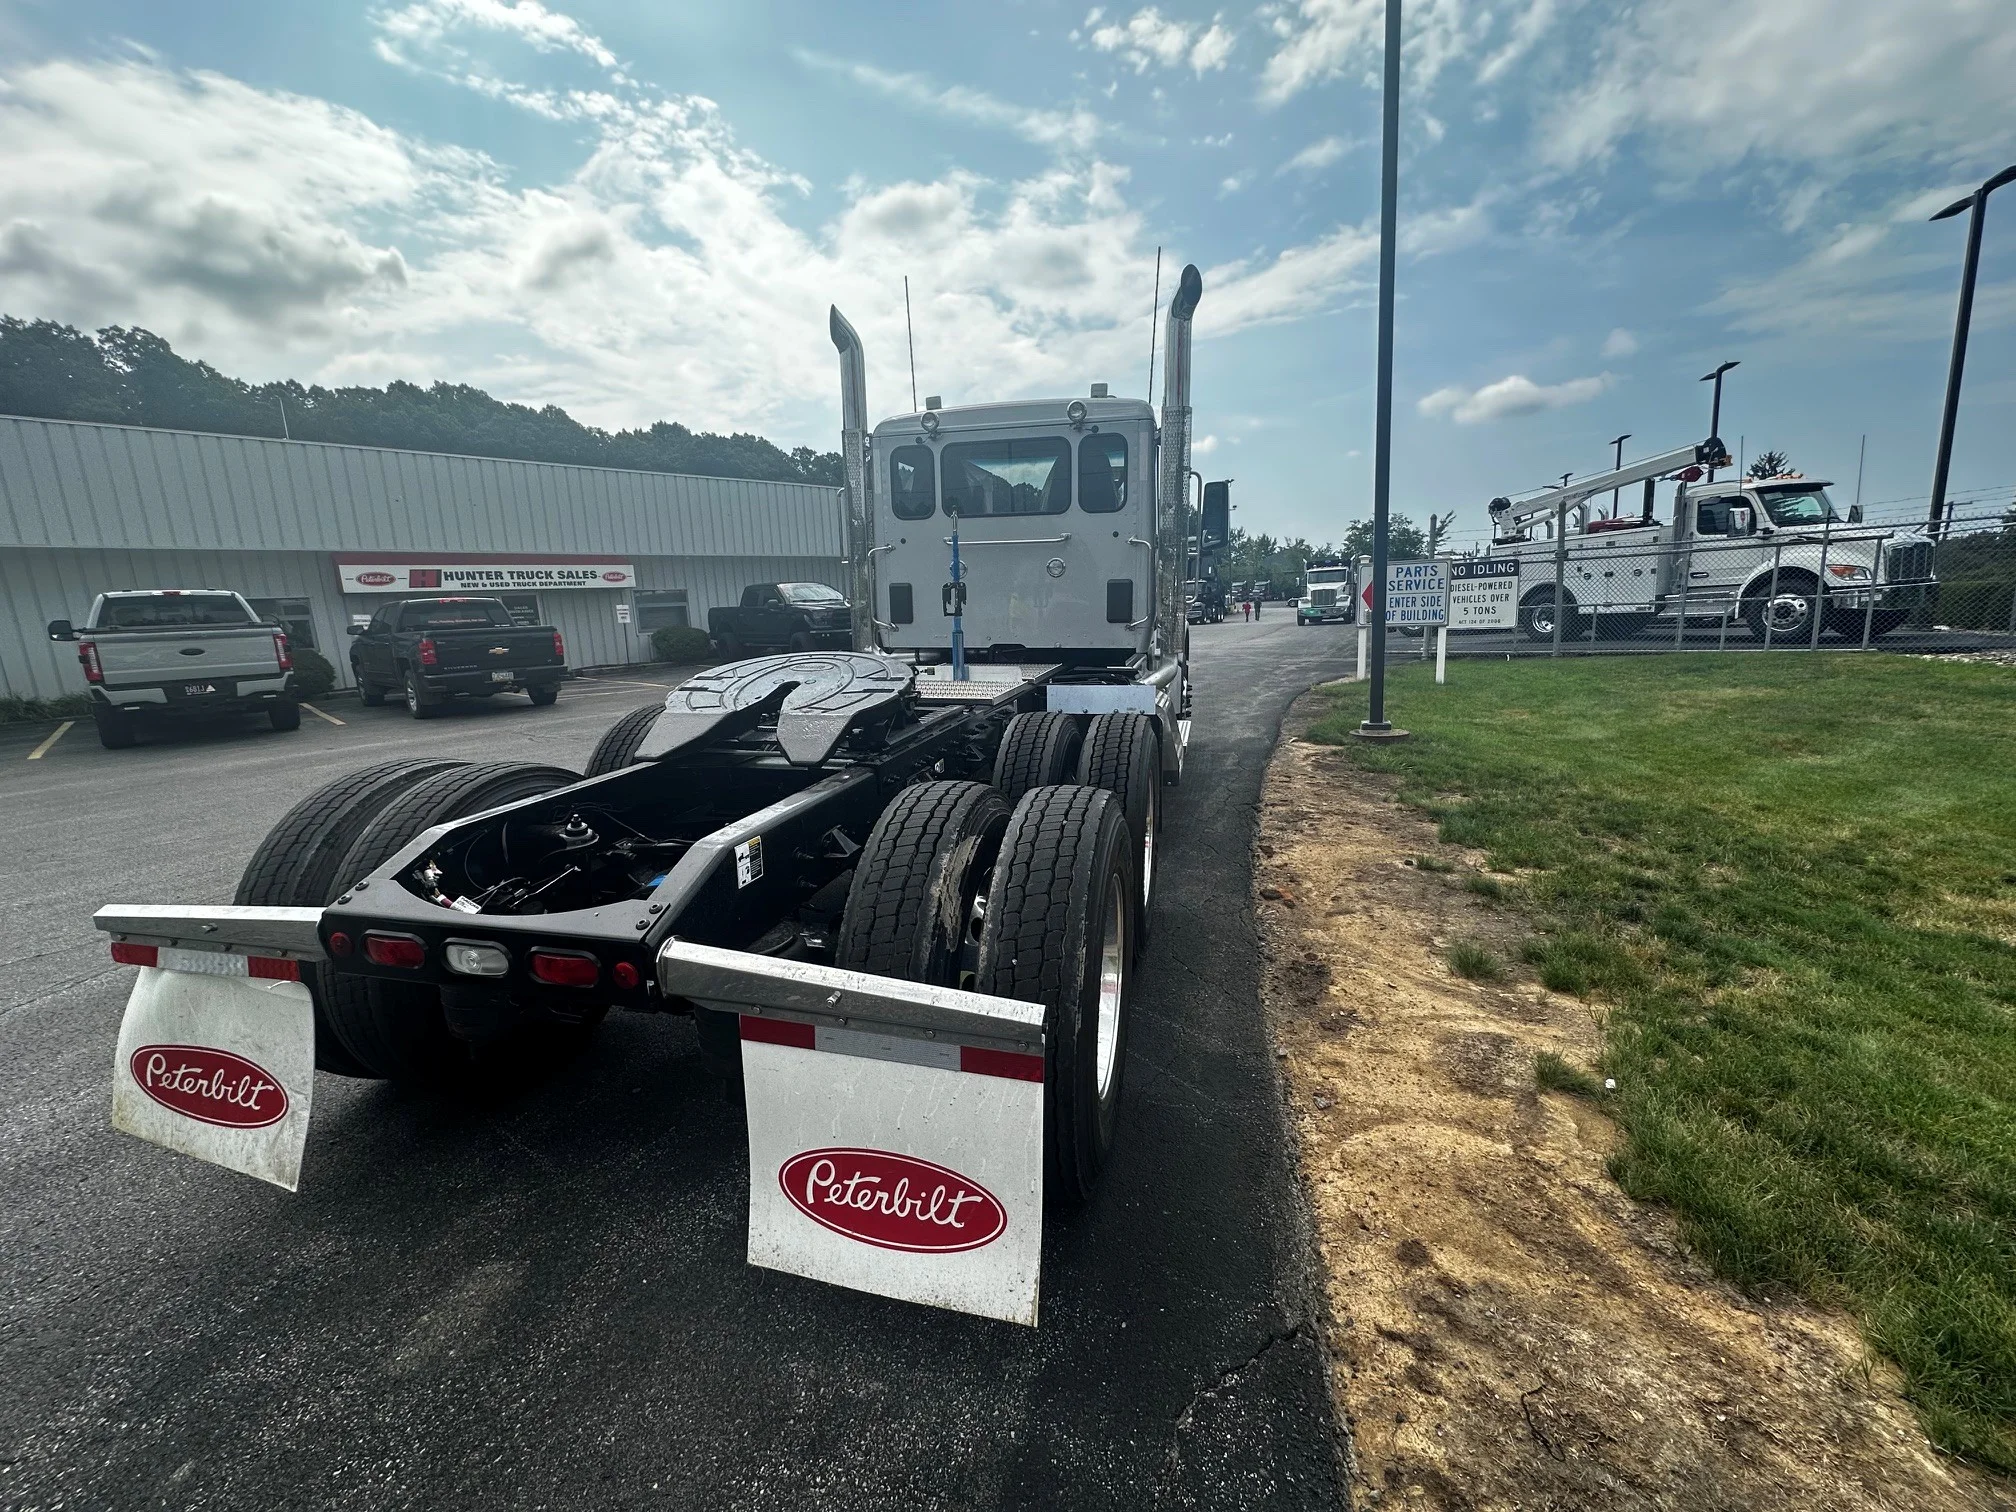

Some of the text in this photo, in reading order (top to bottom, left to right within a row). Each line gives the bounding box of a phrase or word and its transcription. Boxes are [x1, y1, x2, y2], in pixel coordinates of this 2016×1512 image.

[443, 570, 598, 581] HUNTER TRUCK SALES
[1396, 565, 1438, 578] PARTS
[1451, 562, 1515, 576] NO IDLING
[1388, 578, 1445, 591] SERVICE
[1451, 581, 1513, 592] DIESEL-POWERED
[1389, 595, 1442, 608] ENTER SIDE
[1453, 593, 1510, 604] VEHICLES OVER
[1385, 609, 1444, 621] OF BUILDING
[1463, 606, 1497, 616] 5 TONS
[146, 1053, 275, 1110] Peterbilt
[806, 1159, 983, 1229] Peterbilt
